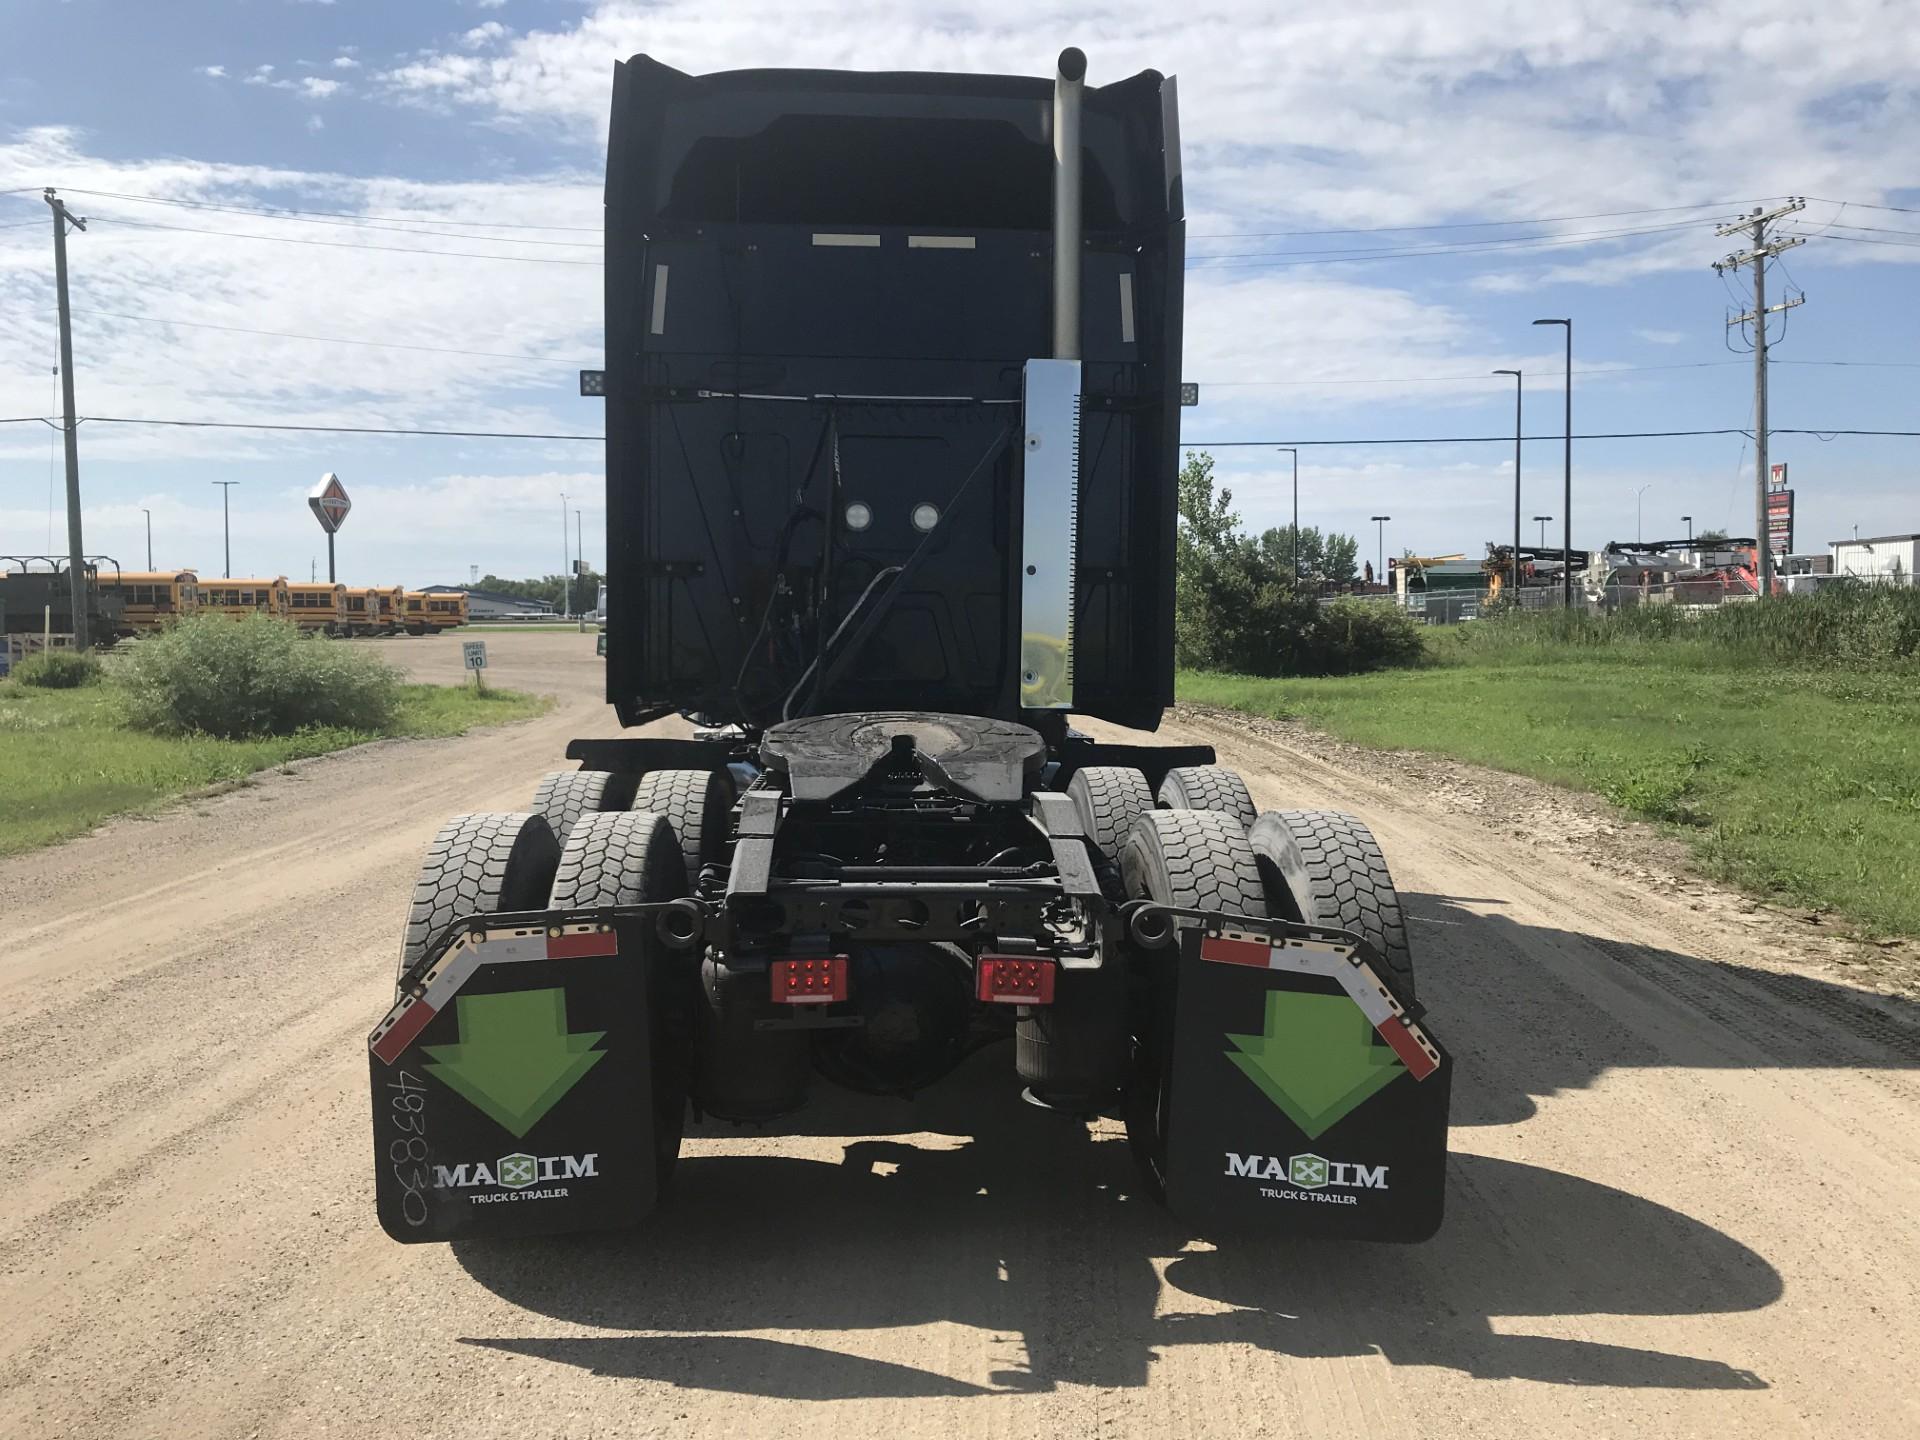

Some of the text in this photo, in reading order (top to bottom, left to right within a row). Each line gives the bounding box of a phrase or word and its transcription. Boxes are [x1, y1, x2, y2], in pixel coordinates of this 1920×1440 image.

[469, 656, 483, 667] 10
[387, 1069, 430, 1226] 483830
[432, 1152, 599, 1189] MAXIM
[1224, 1153, 1389, 1190] MAXIM
[470, 1193, 509, 1204] TRUCK
[519, 1188, 568, 1201] TRAILER
[1260, 1188, 1298, 1201] TRUCK
[1309, 1192, 1358, 1205] TRAILER
